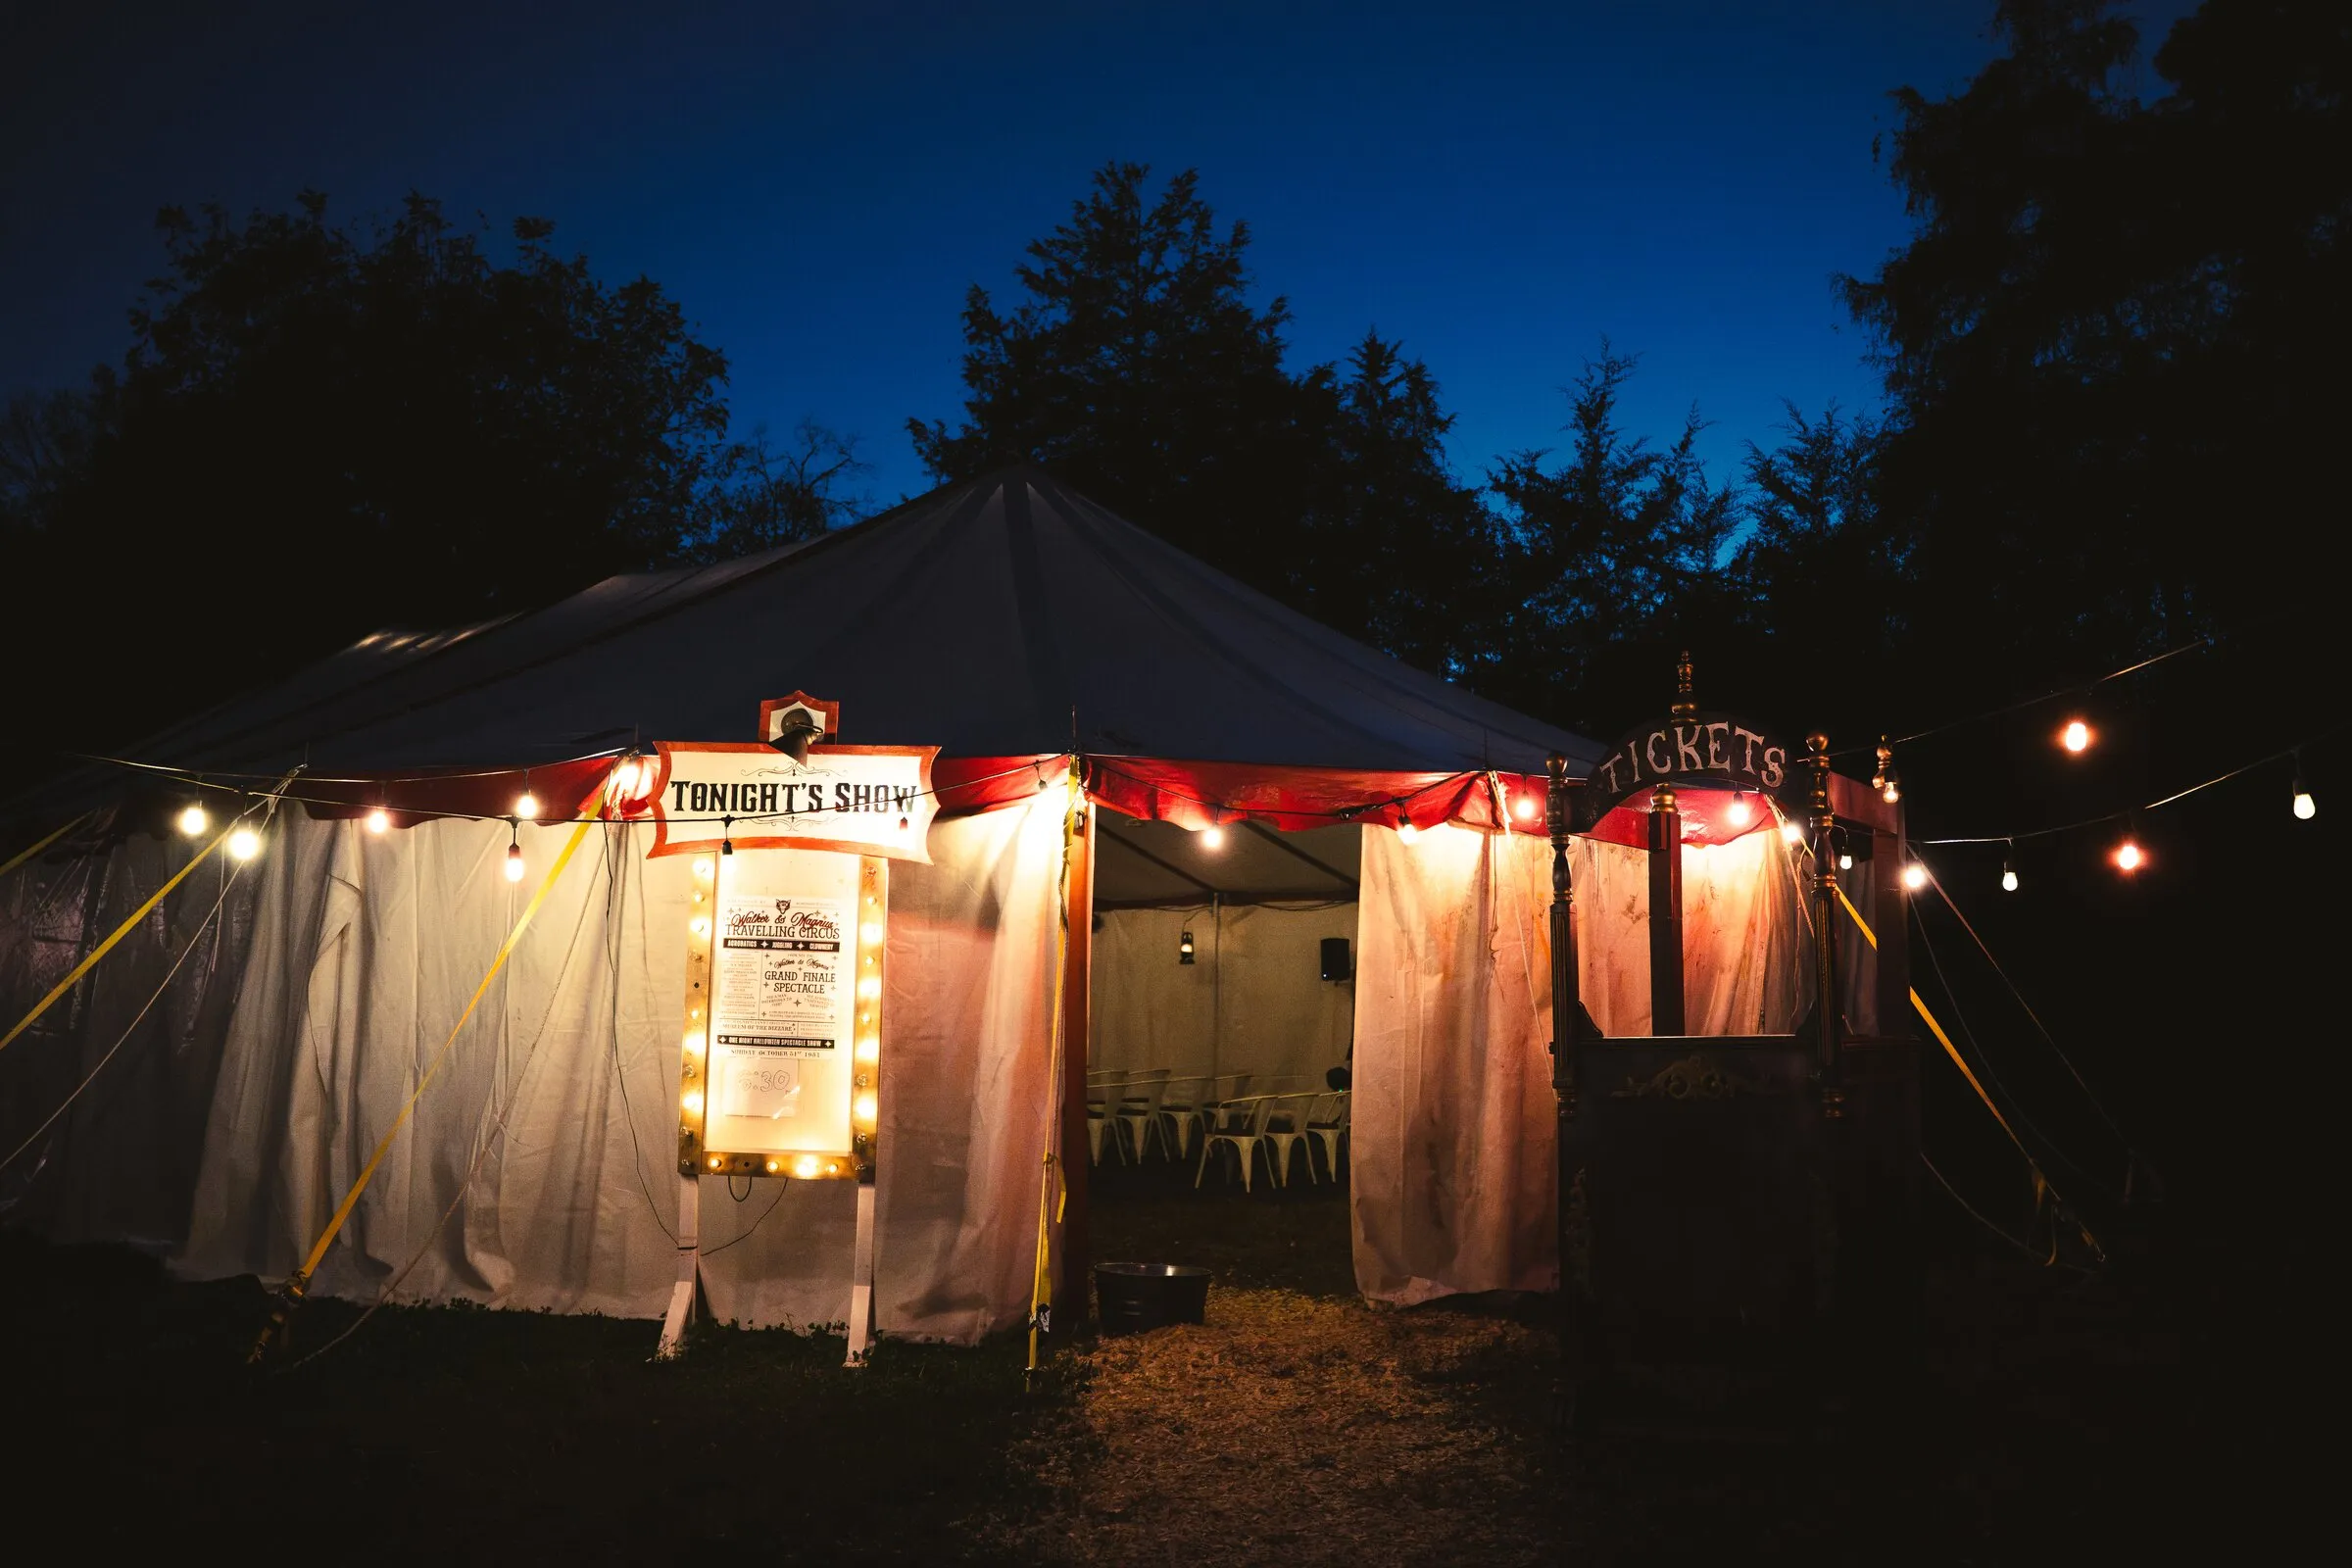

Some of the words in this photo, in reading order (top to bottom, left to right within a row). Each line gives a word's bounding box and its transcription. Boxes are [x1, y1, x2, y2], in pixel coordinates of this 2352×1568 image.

[1599, 721, 1786, 793] TICKETS
[669, 780, 823, 813] TONIGHT'S
[834, 781, 917, 814] SHOW
[730, 910, 770, 926] Walker
[774, 915, 786, 924] &
[790, 911, 834, 929] Magnus
[725, 924, 795, 938] TRAVELLING
[799, 926, 840, 939] CIRCUS
[764, 970, 798, 981] GRAND
[803, 972, 836, 983] FINALE
[773, 983, 825, 994] SPECTACLE
